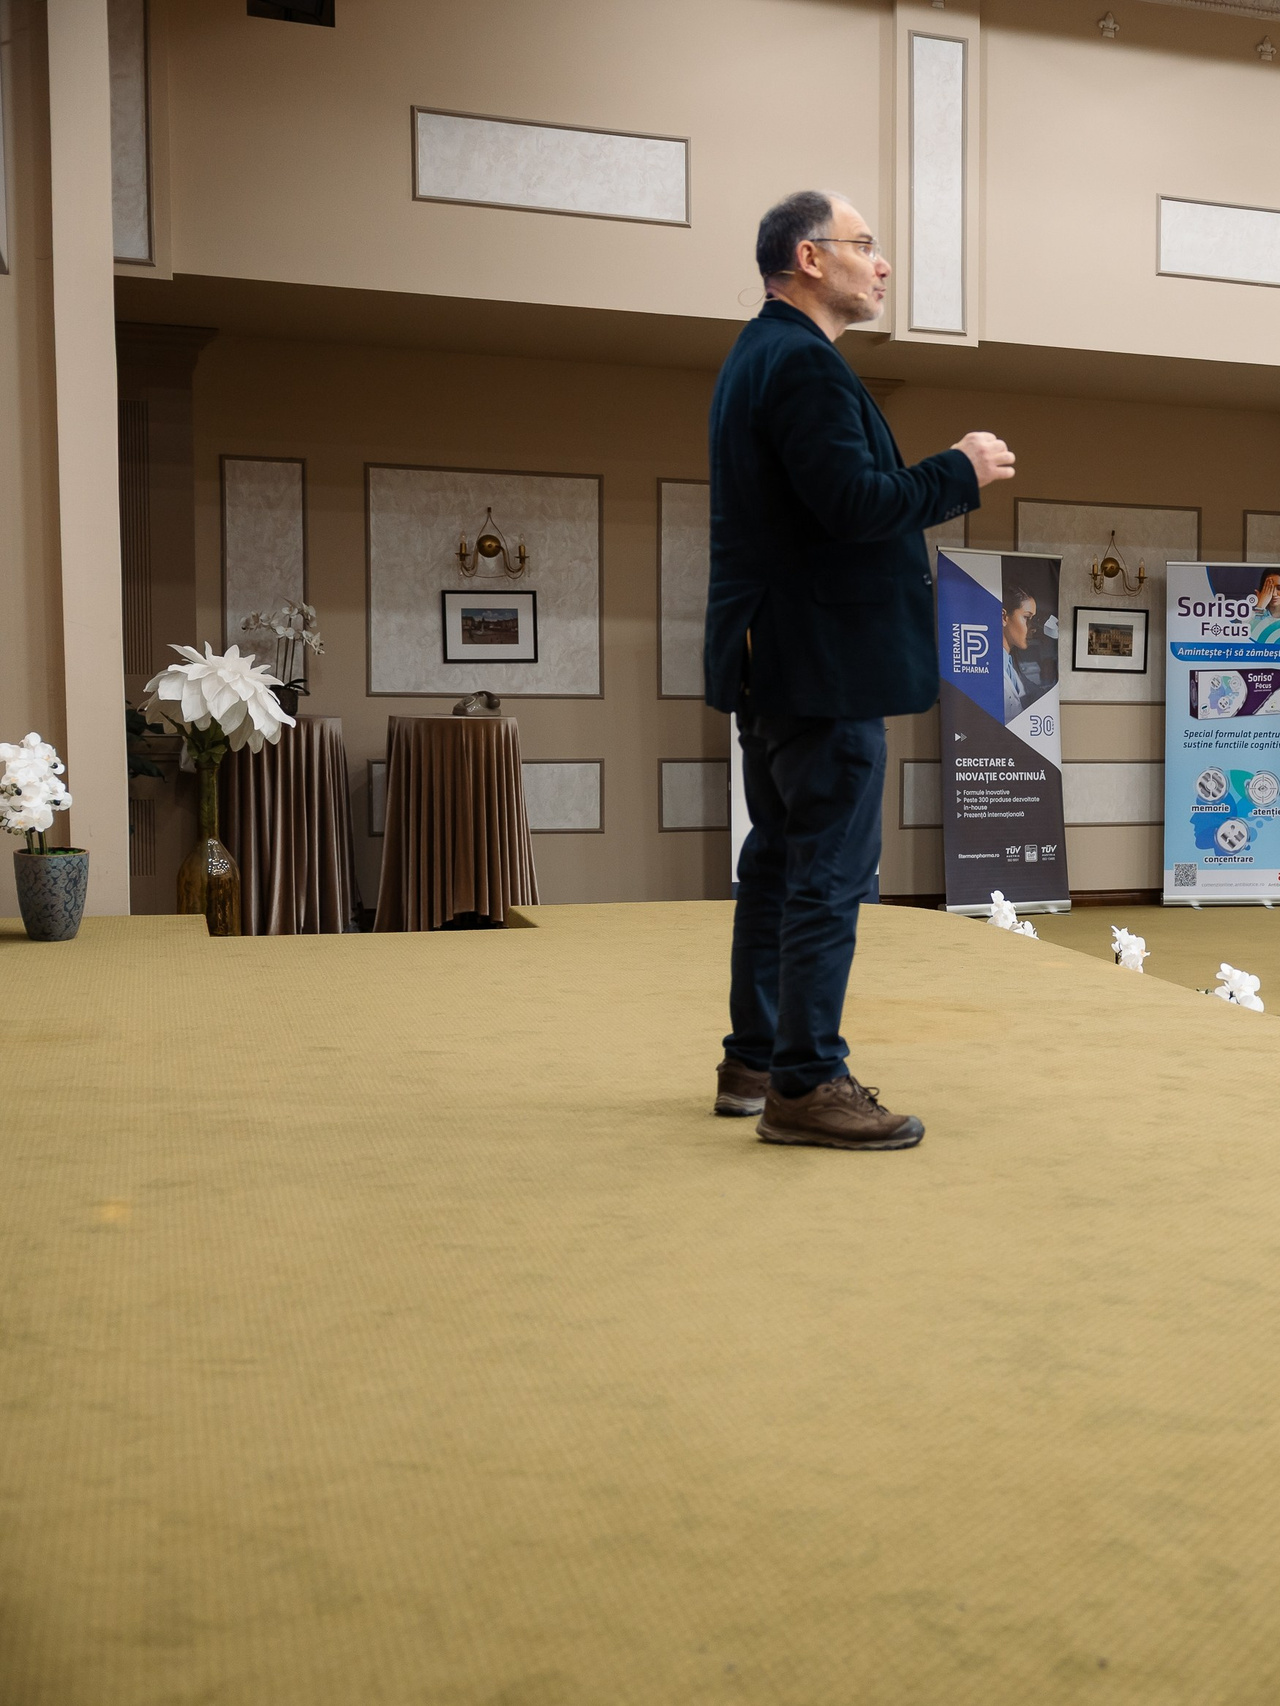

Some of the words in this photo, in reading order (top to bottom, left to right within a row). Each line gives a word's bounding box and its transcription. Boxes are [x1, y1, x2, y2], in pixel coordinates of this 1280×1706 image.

[952, 623, 961, 673] FITERMAN
[1234, 648, 1244, 656] să
[961, 665, 990, 674] PHARMA
[1029, 715, 1054, 737] 30
[1183, 729, 1214, 739] Special
[1214, 729, 1252, 739] formulat
[1253, 731, 1280, 740] pentru
[955, 758, 1007, 767] CERCETARE
[1007, 758, 1016, 767] &
[998, 769, 1046, 781] CONTINUĂ
[1191, 804, 1230, 812] memorie
[1005, 845, 1021, 854] TÜV
[1041, 844, 1057, 853] TÜV
[1204, 855, 1254, 863] concentrare
